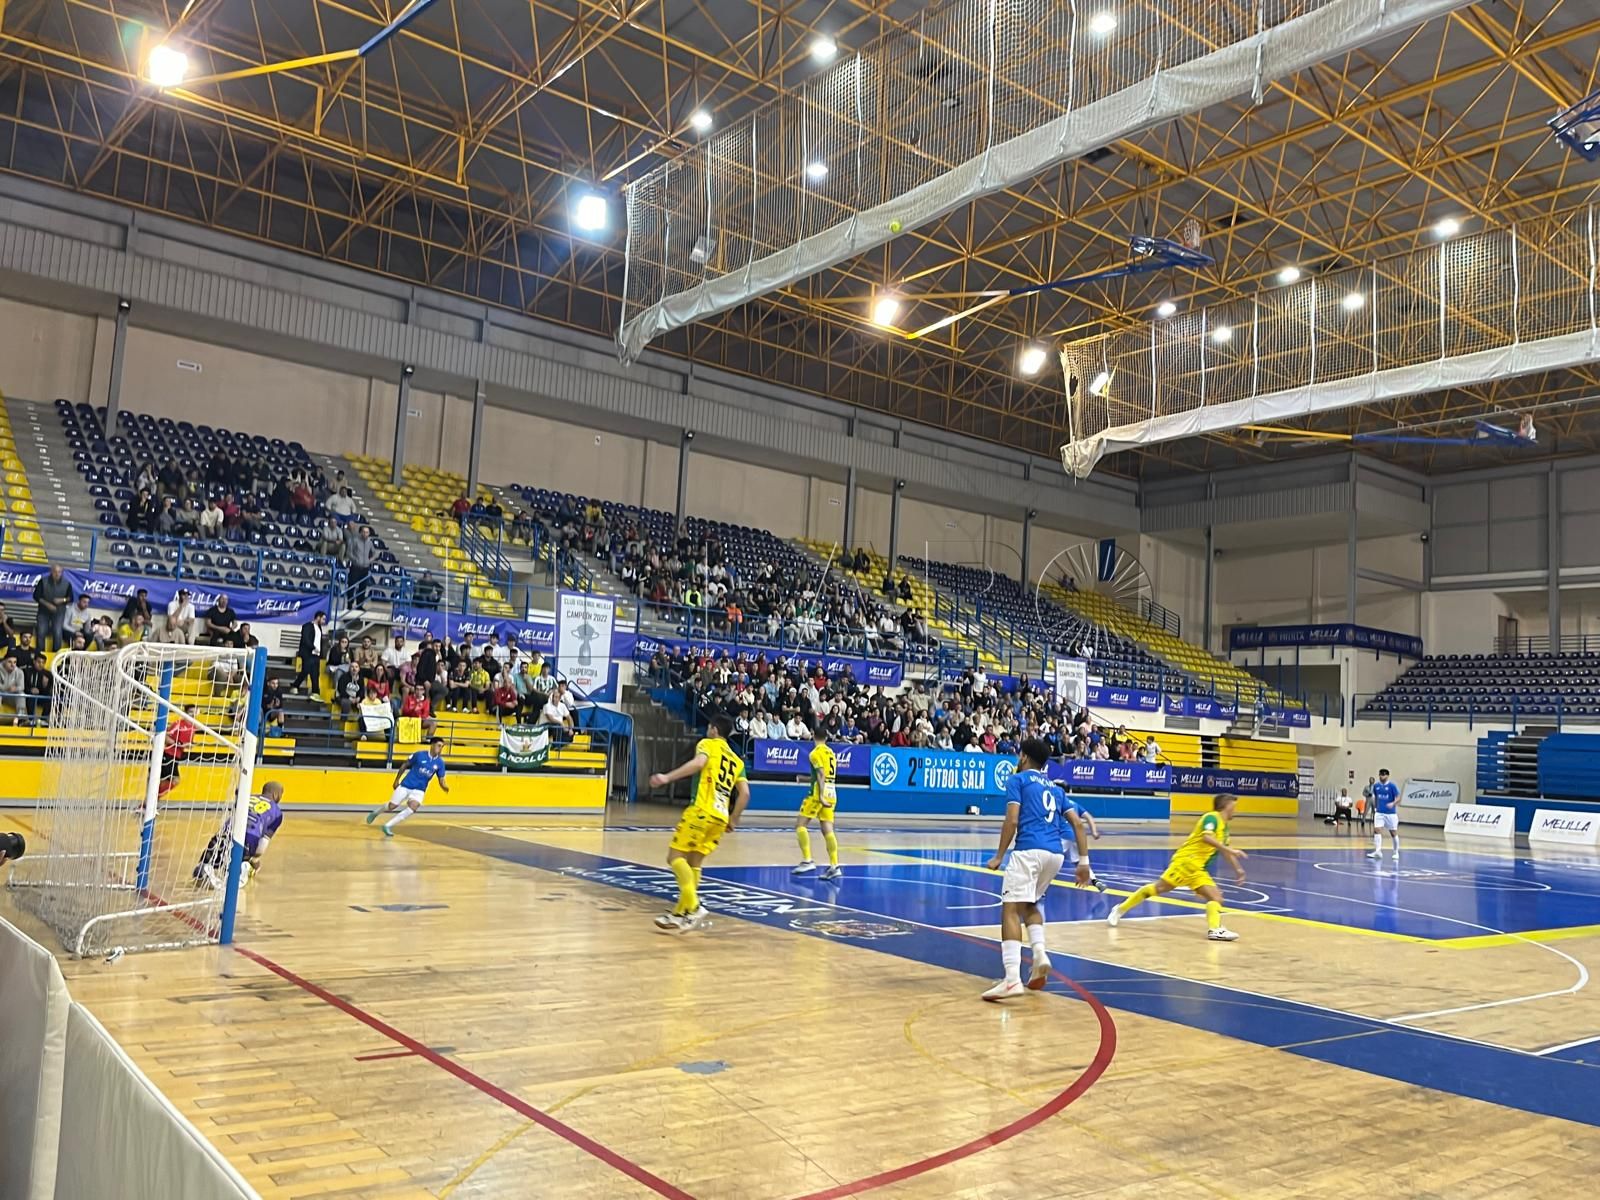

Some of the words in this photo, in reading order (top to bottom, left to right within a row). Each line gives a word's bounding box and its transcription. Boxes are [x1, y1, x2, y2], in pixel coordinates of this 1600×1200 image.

[0, 571, 42, 587] ELILLA
[83, 580, 136, 597] MELILLA
[457, 622, 496, 634] MELILLA
[518, 628, 554, 641] MELILLA
[766, 747, 799, 760] MELILLA
[829, 757, 835, 775] 5
[925, 757, 986, 769] DIVISIÓN
[717, 754, 737, 789] 55
[923, 765, 960, 789] FÚTBOL
[961, 769, 985, 790] SALA
[1042, 790, 1057, 823] 9
[1454, 811, 1502, 824] MELILLA
[1541, 818, 1592, 832] MELILLA
